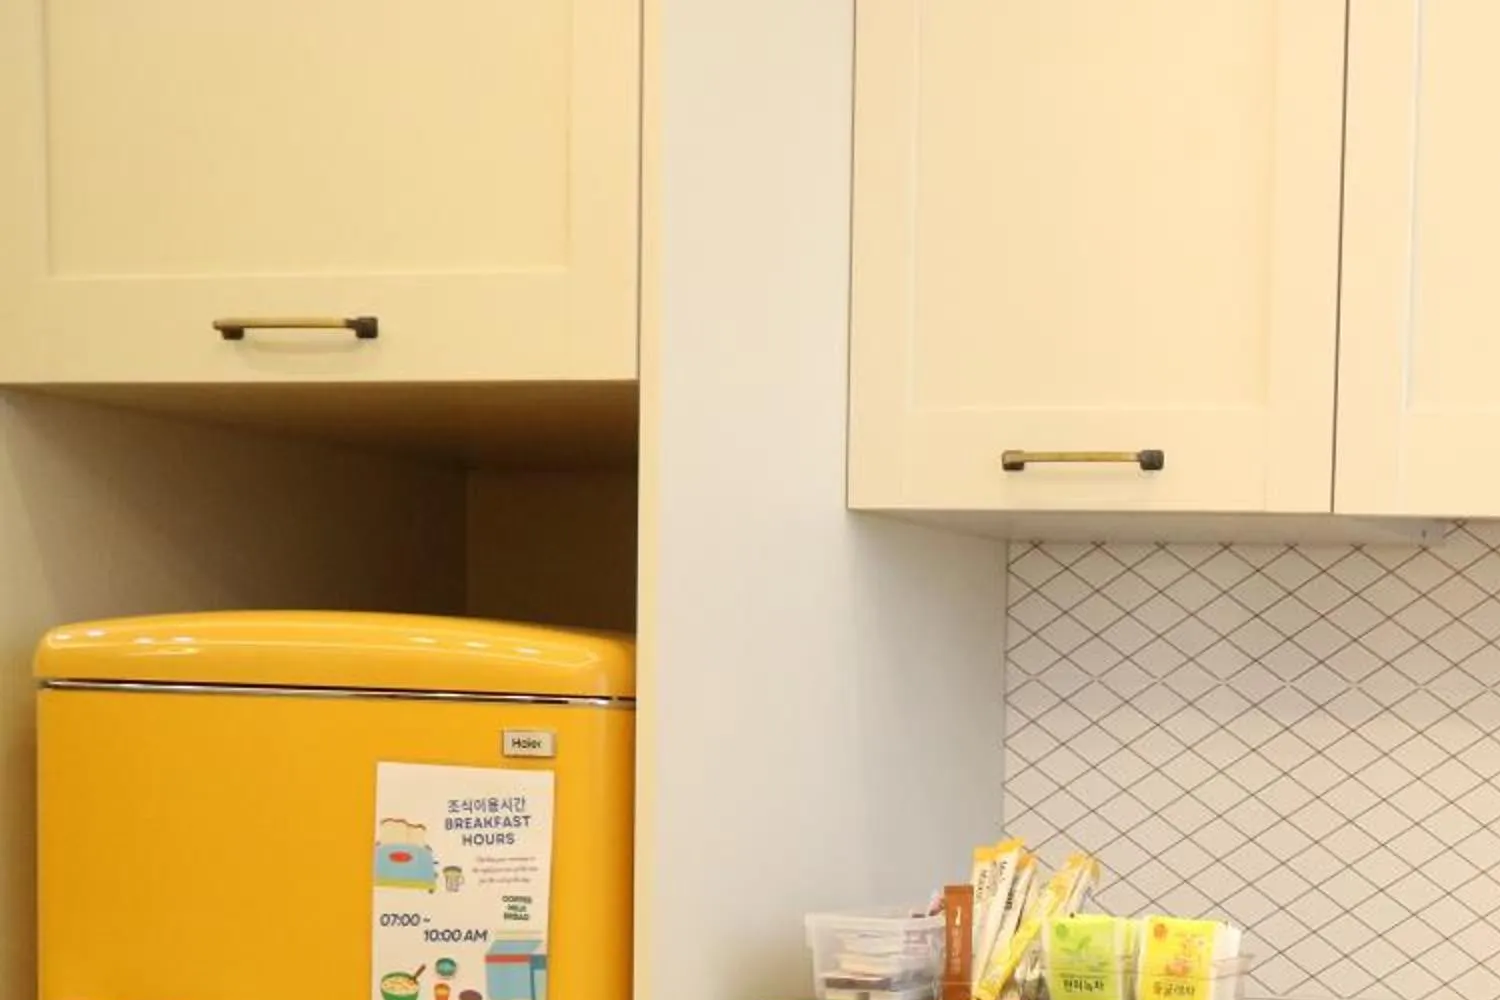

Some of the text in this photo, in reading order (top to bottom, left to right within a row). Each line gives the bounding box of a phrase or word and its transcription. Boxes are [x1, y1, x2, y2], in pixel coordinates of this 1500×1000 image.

[511, 738, 542, 749] Haier
[447, 796, 526, 814] 조식이용시간
[445, 815, 531, 830] BREAKFAST
[462, 833, 515, 846] HOURS
[380, 913, 421, 927] 07:00
[424, 929, 489, 942] 10:00 AM
